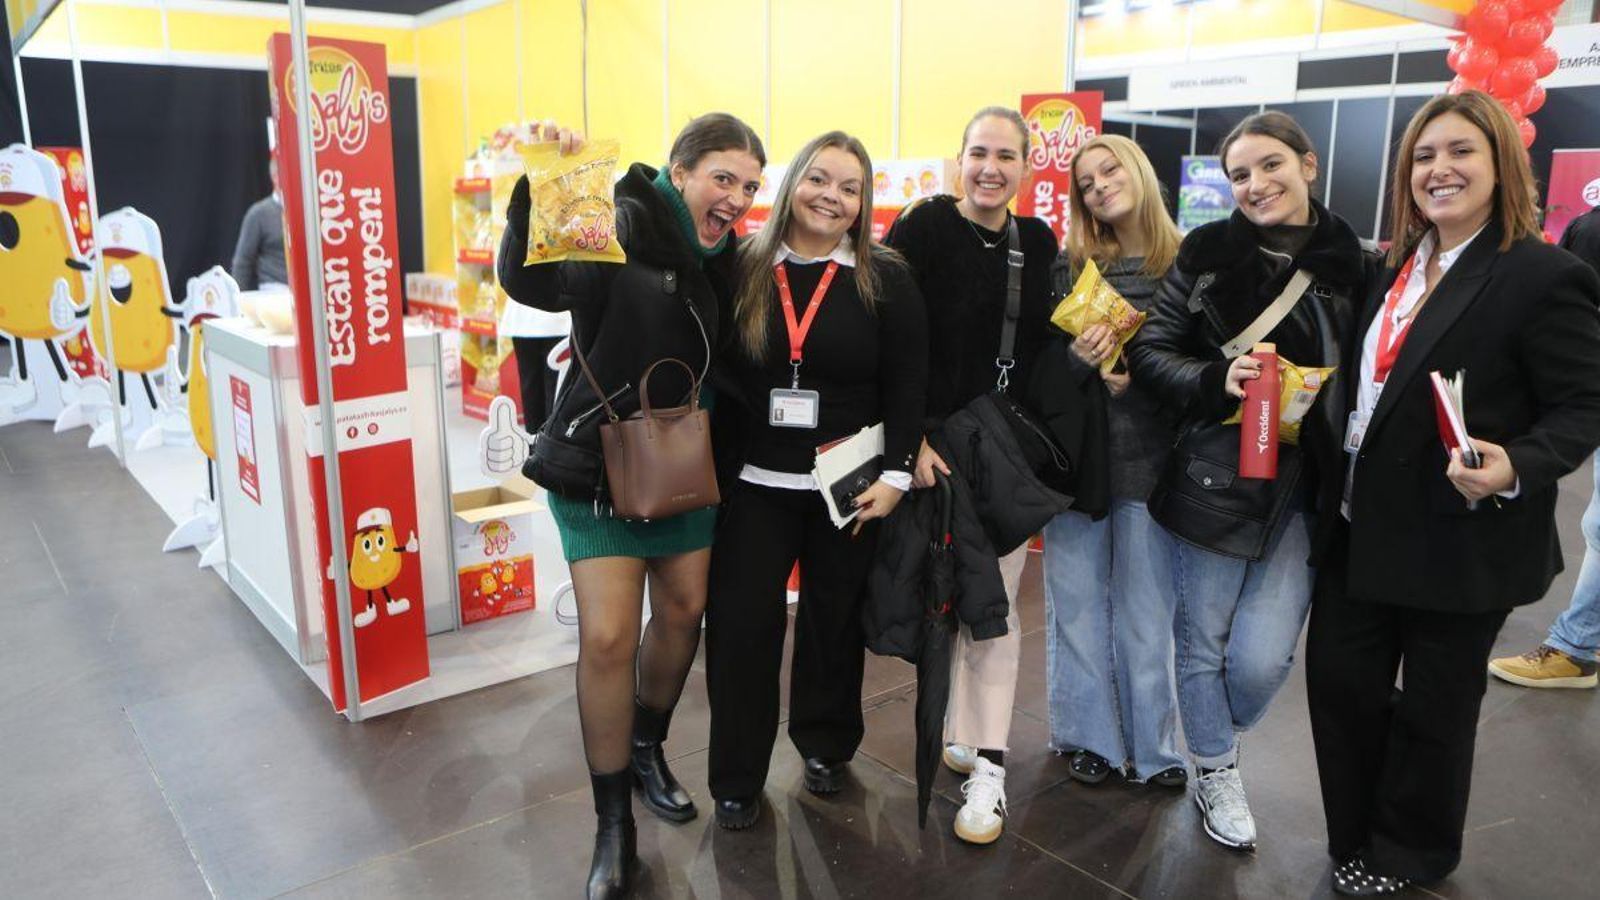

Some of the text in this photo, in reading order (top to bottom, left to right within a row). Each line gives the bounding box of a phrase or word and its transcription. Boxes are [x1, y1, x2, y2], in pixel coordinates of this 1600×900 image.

[1589, 42, 1600, 53] A
[318, 168, 354, 245] que
[351, 186, 392, 346] rompen!
[1259, 400, 1269, 442] Occident
